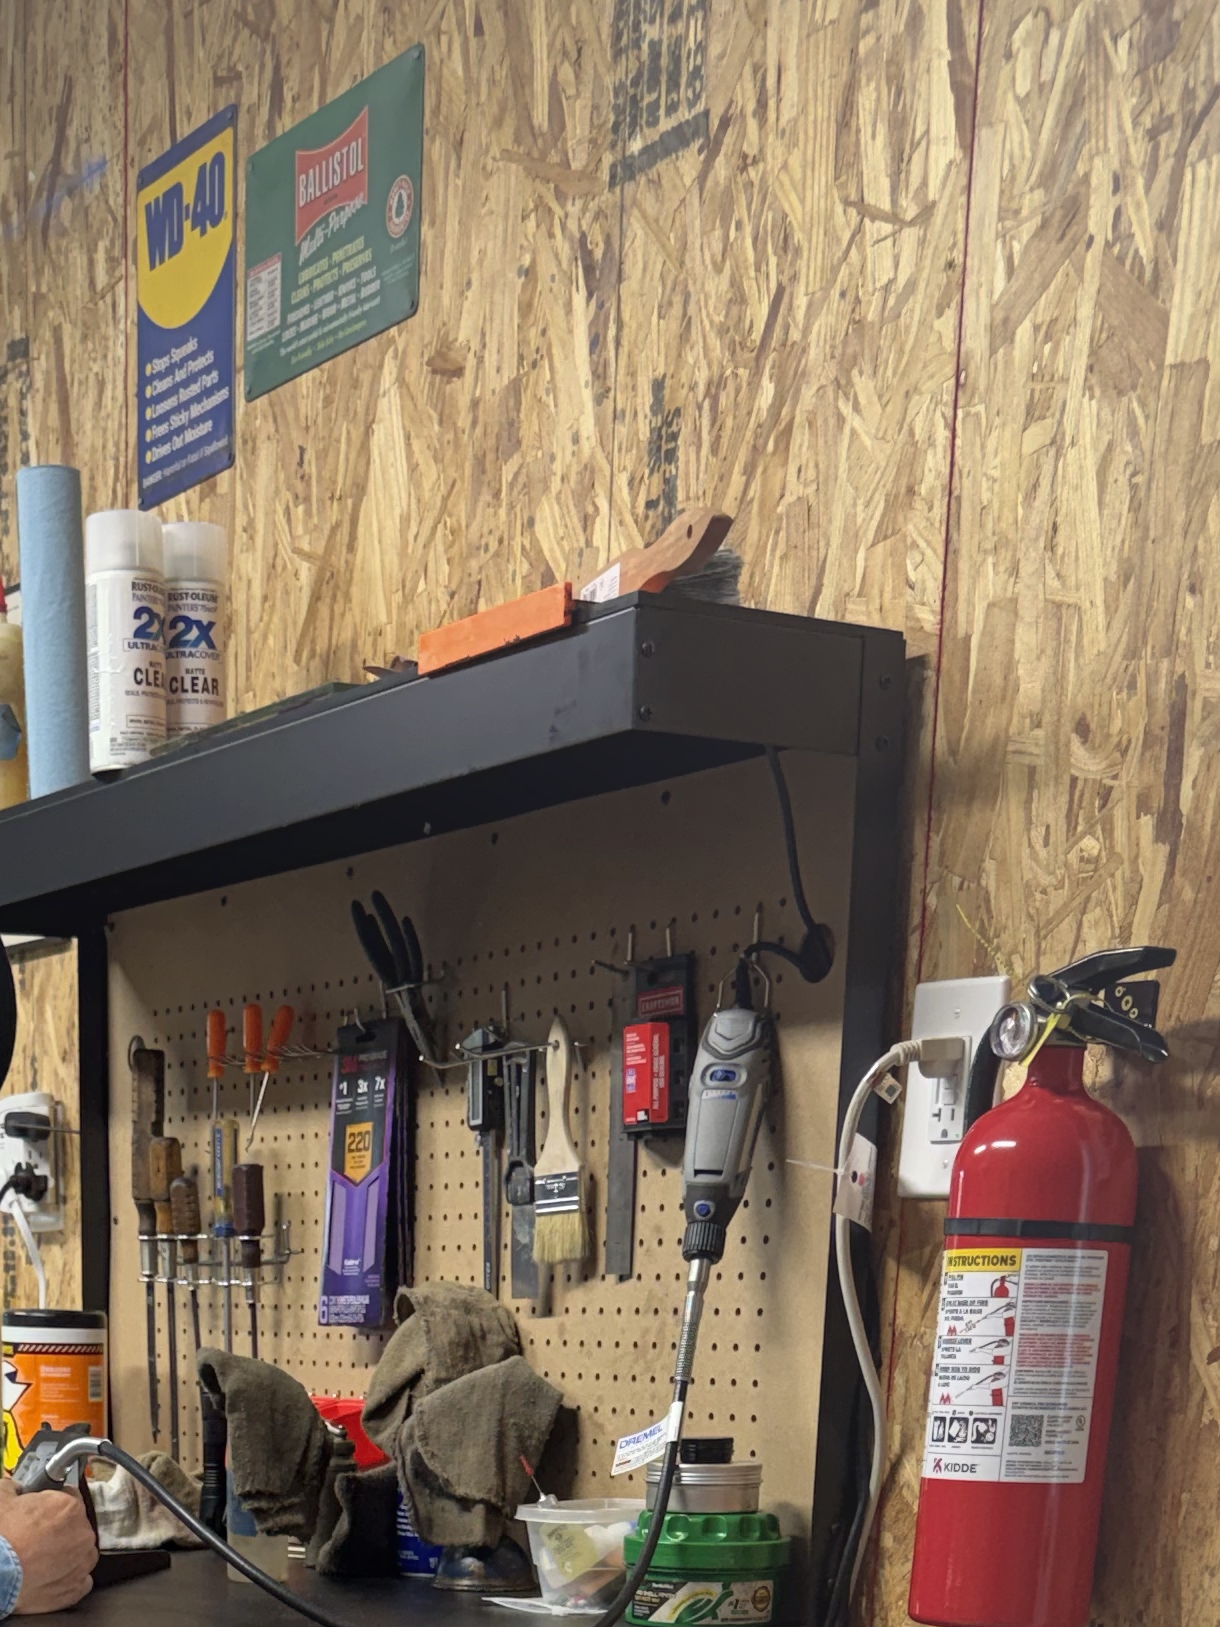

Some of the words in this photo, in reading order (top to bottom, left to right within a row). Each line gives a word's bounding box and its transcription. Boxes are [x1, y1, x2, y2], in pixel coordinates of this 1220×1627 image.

[299, 137, 364, 208] BALLISTOL
[144, 150, 226, 272] WD-40
[169, 615, 216, 650] 2X
[169, 676, 219, 696] CLEAR
[347, 1131, 371, 1153] 220
[320, 1295, 328, 1324] 6
[619, 1424, 663, 1449] DREMEL
[944, 1463, 977, 1473] KIDDE
